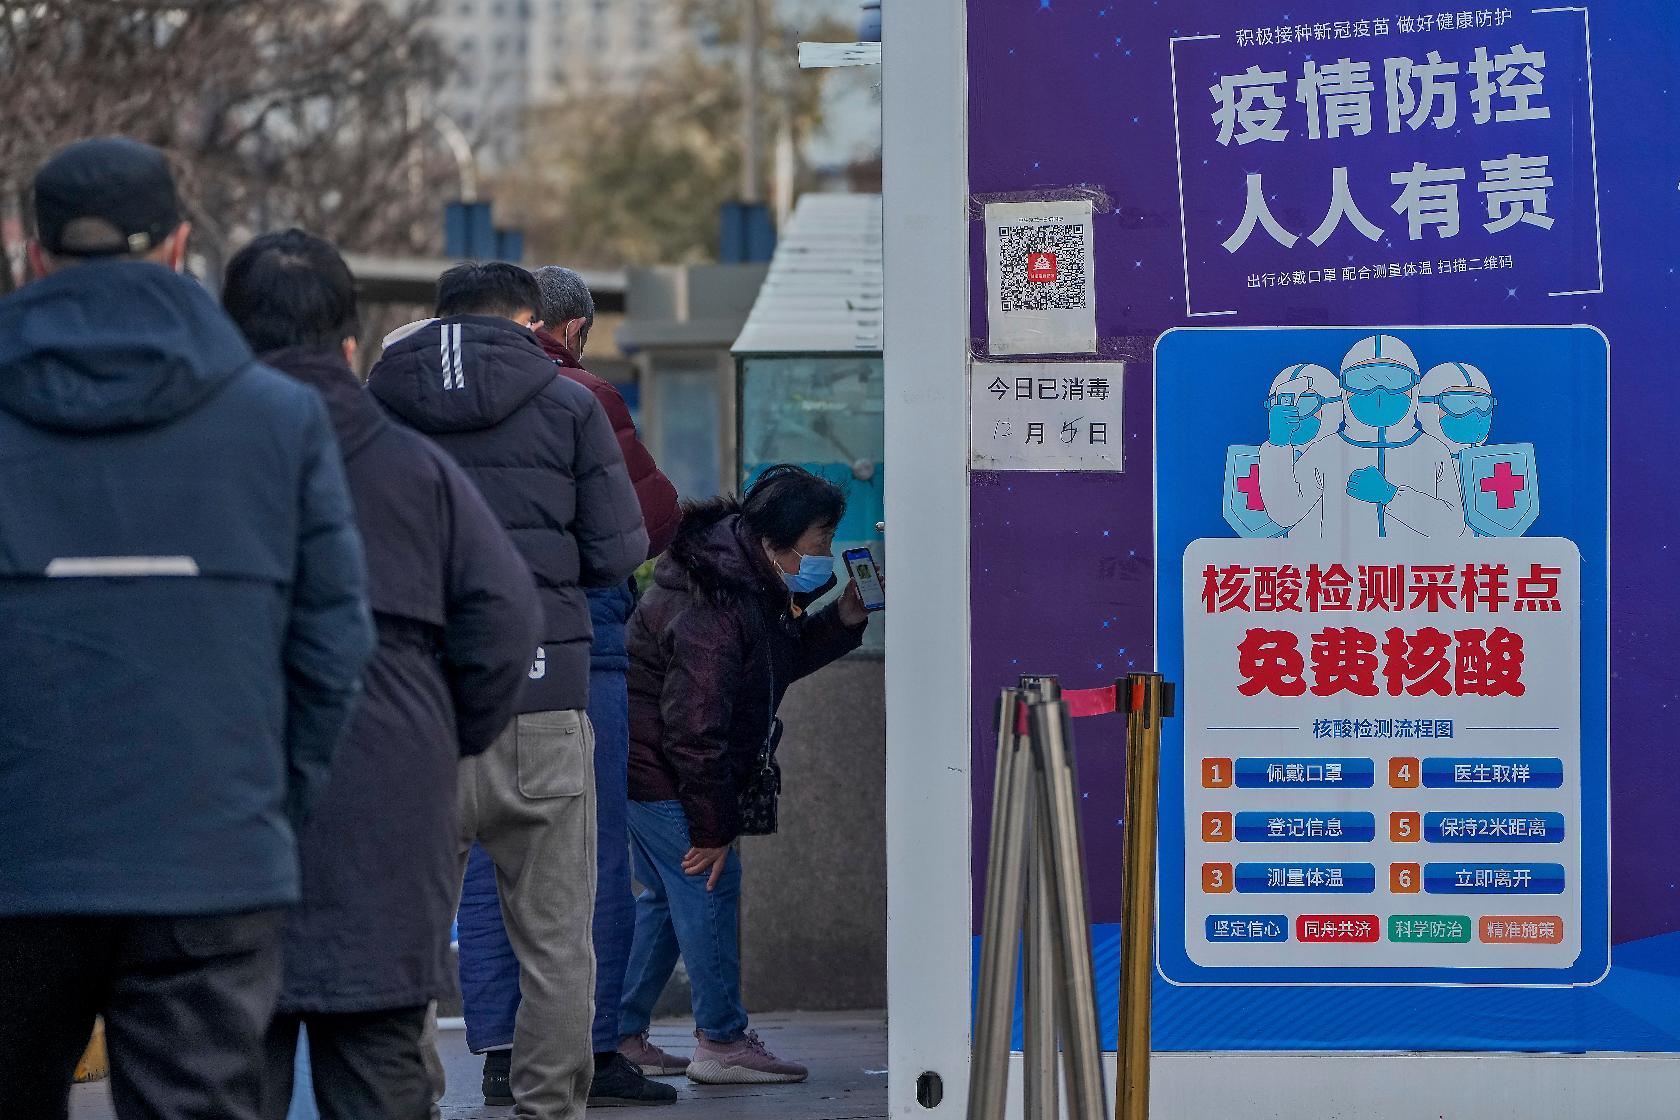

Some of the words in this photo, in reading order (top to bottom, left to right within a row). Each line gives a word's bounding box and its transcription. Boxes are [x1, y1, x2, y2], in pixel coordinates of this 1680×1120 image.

[1236, 17, 1390, 47] 积极接种新冠疫苗
[1397, 8, 1513, 35] 做好健康防护
[1209, 43, 1551, 147] 疫情防控
[1221, 153, 1555, 253] 人人有责
[1246, 268, 1337, 289] 出行必戴口罩
[1341, 261, 1433, 282] 配合测量体温
[1437, 255, 1514, 275] 扫描二维码
[987, 376, 1110, 401] 今日已消毒
[1025, 422, 1045, 445] 月
[1089, 422, 1107, 445] 日
[1201, 563, 1563, 613] 核酸检测采样点
[1236, 626, 1526, 697] 免费核酸
[1312, 718, 1455, 739] 核酸检测流程图
[1210, 764, 1223, 783] 1
[1266, 763, 1343, 783] 佩戴口罩
[1397, 763, 1411, 783] 4
[1453, 764, 1531, 783] 医生取样
[1210, 818, 1223, 837] 2
[1266, 817, 1344, 837] 登记信息
[1399, 818, 1411, 837] 5
[1439, 817, 1547, 837] 保持2米距离
[1210, 869, 1223, 888] 3
[1266, 867, 1344, 888] 测量体温
[1398, 868, 1411, 888] 6
[1454, 869, 1532, 888] 立即离开
[1213, 920, 1282, 938] 坚定信心
[1303, 920, 1372, 939] 同舟共济
[1395, 921, 1463, 939] 科学防治
[1487, 921, 1556, 939] 精准施策
